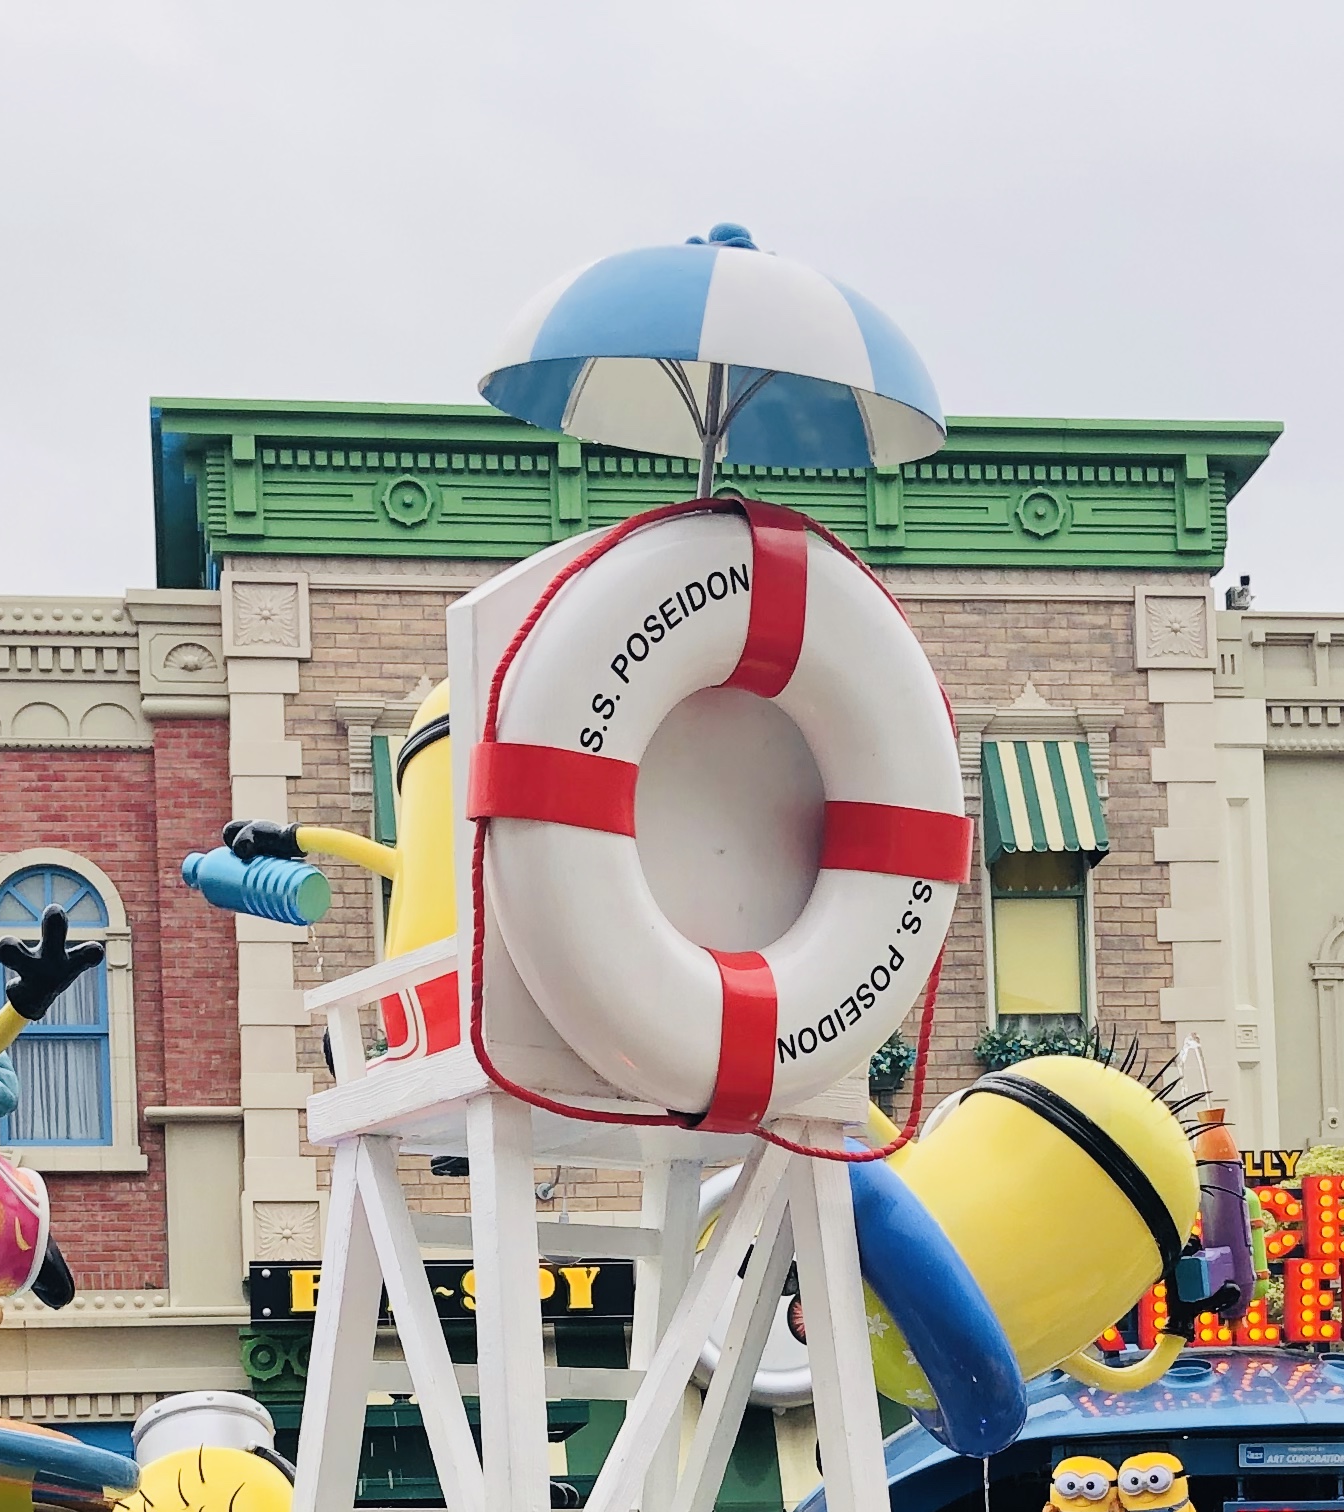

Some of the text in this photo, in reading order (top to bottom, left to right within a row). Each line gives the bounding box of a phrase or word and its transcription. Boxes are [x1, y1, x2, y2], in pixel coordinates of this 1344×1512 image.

[579, 563, 752, 754] S.S. POSEIDON
[777, 879, 934, 1063] S.S. POSEIDON
[1244, 1151, 1302, 1178] LLY
[1266, 1454, 1285, 1464] ART
